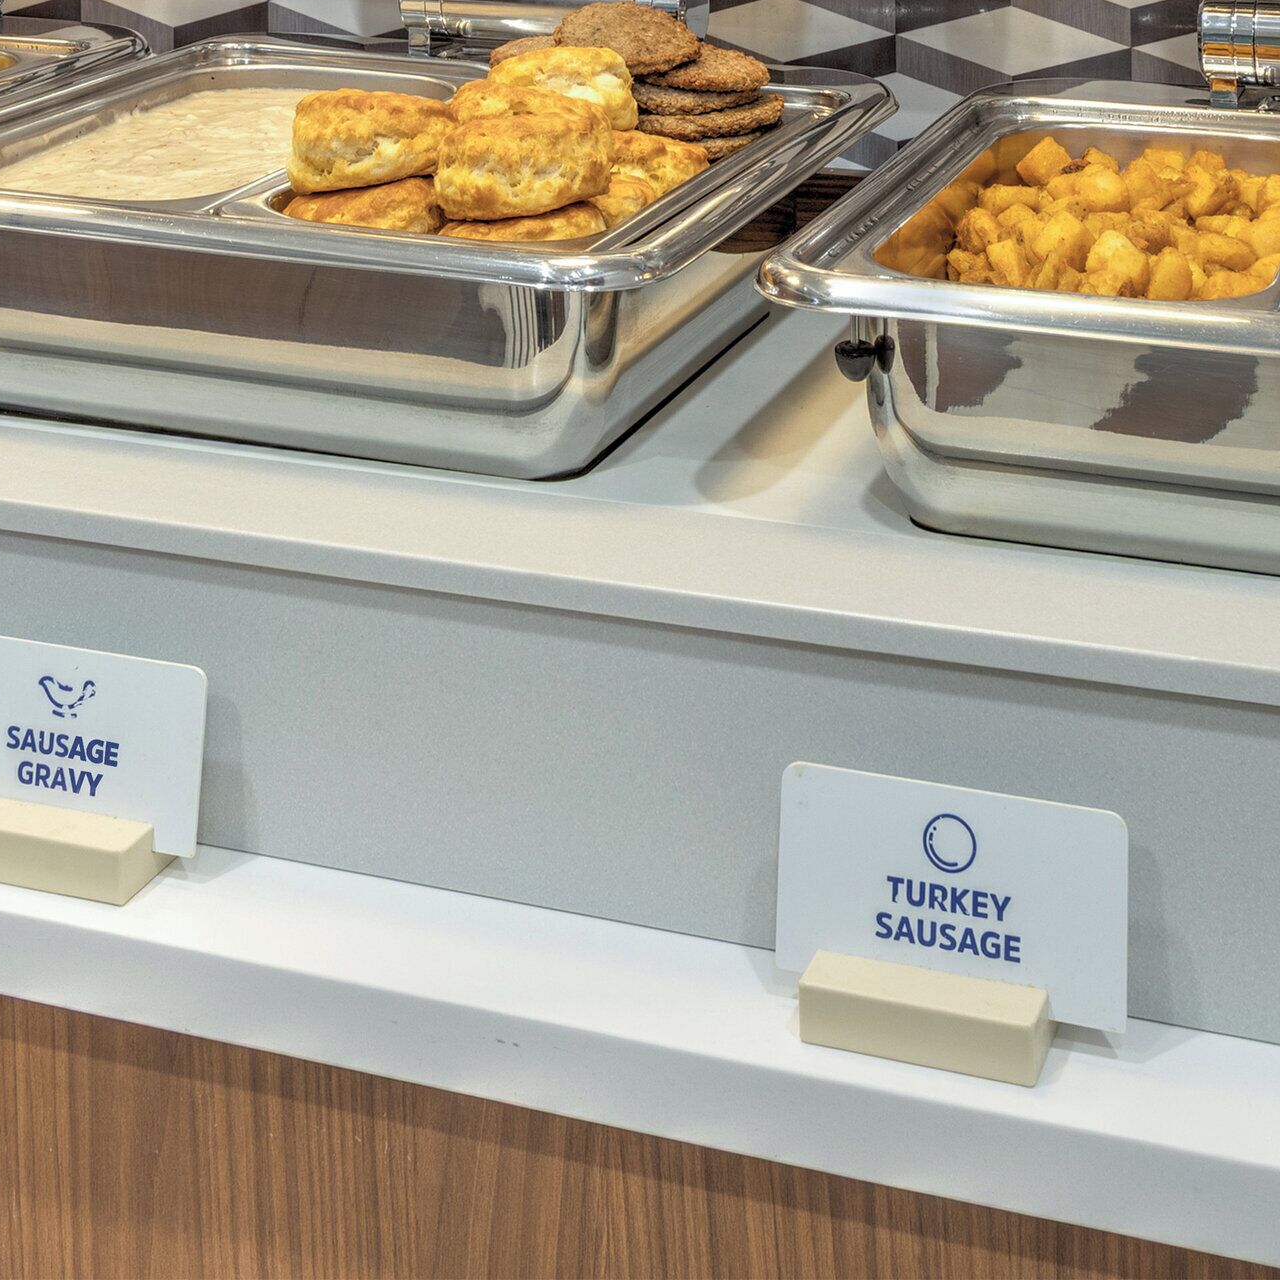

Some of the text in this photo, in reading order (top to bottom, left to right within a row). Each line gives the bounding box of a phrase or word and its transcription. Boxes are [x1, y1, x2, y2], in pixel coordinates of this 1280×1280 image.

[6, 725, 119, 767] SAUSAGE
[17, 761, 103, 796] GRAVY
[886, 875, 1011, 921] TURKEY
[875, 912, 1021, 963] SAUSAGE
